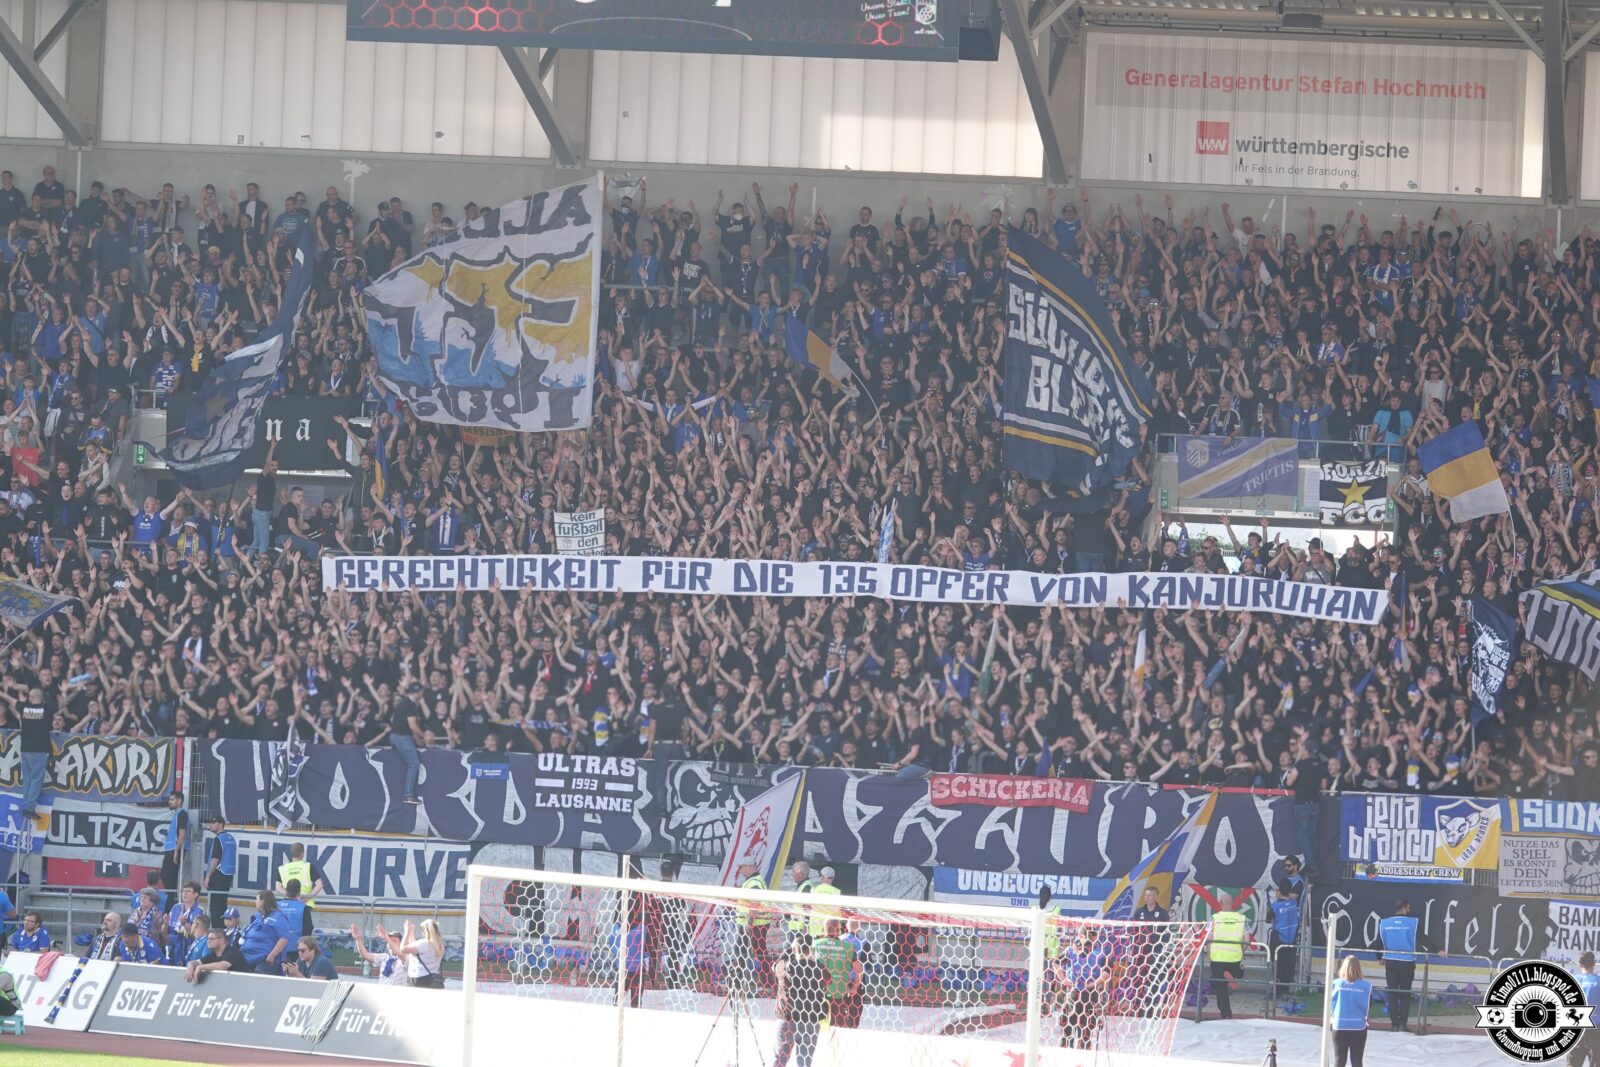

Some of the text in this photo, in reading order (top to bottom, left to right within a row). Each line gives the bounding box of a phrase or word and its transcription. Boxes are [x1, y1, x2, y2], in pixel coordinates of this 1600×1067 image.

[1125, 68, 1487, 100] Generalagentur Stefan Hochmuth
[1236, 135, 1410, 160] württembergische
[1235, 162, 1361, 179] Ihr Fels in der Brandung.
[1242, 459, 1295, 495] TRIPTIS
[1320, 459, 1389, 481] FORZA
[570, 511, 596, 522] kein
[1321, 504, 1386, 526] FCC
[557, 520, 603, 537] fußball
[577, 536, 599, 548] den
[335, 557, 1379, 623] GERECHTIGKEIT FÜR DIE 135 OPFER VON KANJURUHAN
[538, 753, 636, 777] ULTRAS
[571, 777, 599, 790] 1993
[932, 775, 1090, 807] SCHICKERIA
[535, 792, 633, 813] LAUSANNE
[47, 812, 171, 852] ULTRAS
[1503, 839, 1560, 849] NUTZE DAS
[1512, 849, 1551, 860] SPIEL
[957, 868, 1090, 896] UNBEUGSAM
[1377, 866, 1462, 878] ADOLESCENT CREW
[1514, 868, 1549, 878] DEIN
[1500, 879, 1564, 888] LETZTES SEIN
[1010, 897, 1030, 907] UND
[1321, 892, 1534, 957] Salfeld
[1558, 905, 1600, 928] BAM
[116, 986, 256, 1024] SWE Für Erfurt.
[284, 1002, 313, 1028] SW
[335, 1008, 370, 1033] Für
